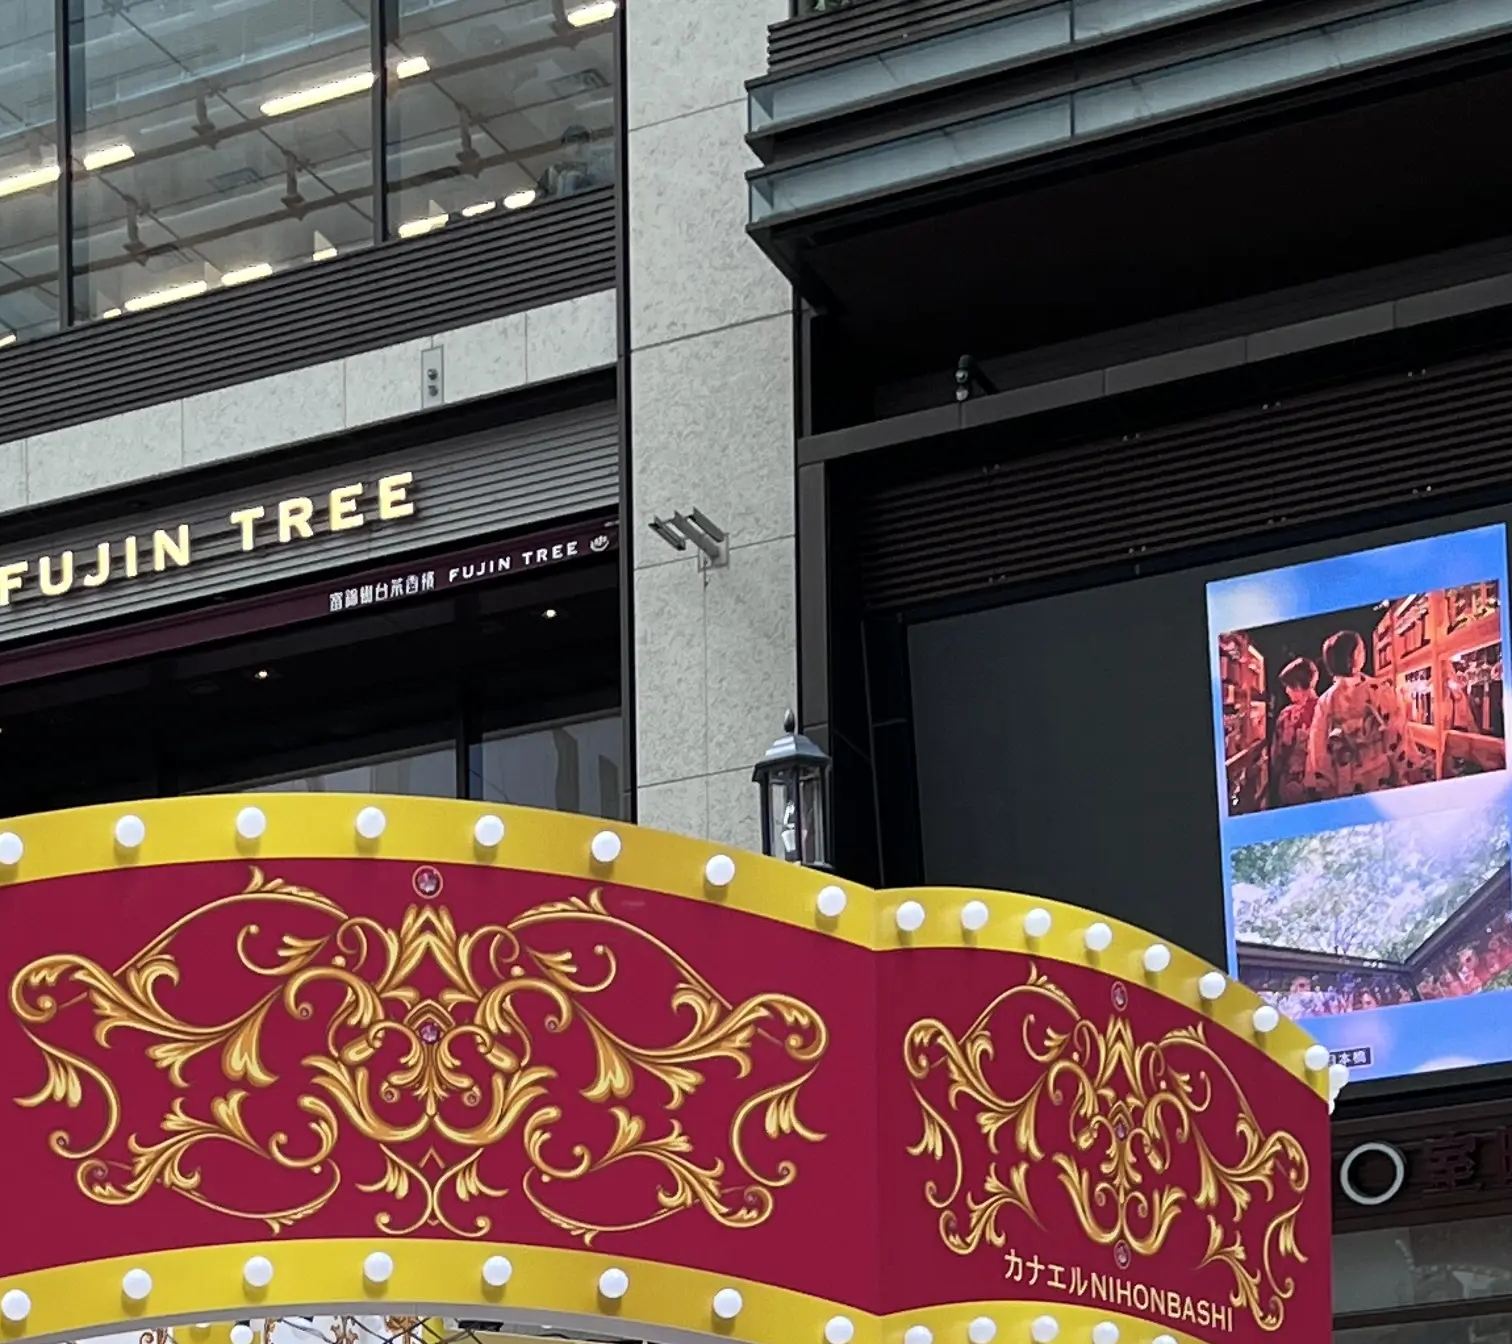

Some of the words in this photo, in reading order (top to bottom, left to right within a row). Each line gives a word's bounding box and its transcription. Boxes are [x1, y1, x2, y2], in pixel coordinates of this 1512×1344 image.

[230, 471, 415, 551] TREE
[448, 556, 512, 583] FUJIN
[521, 540, 578, 566] TREE
